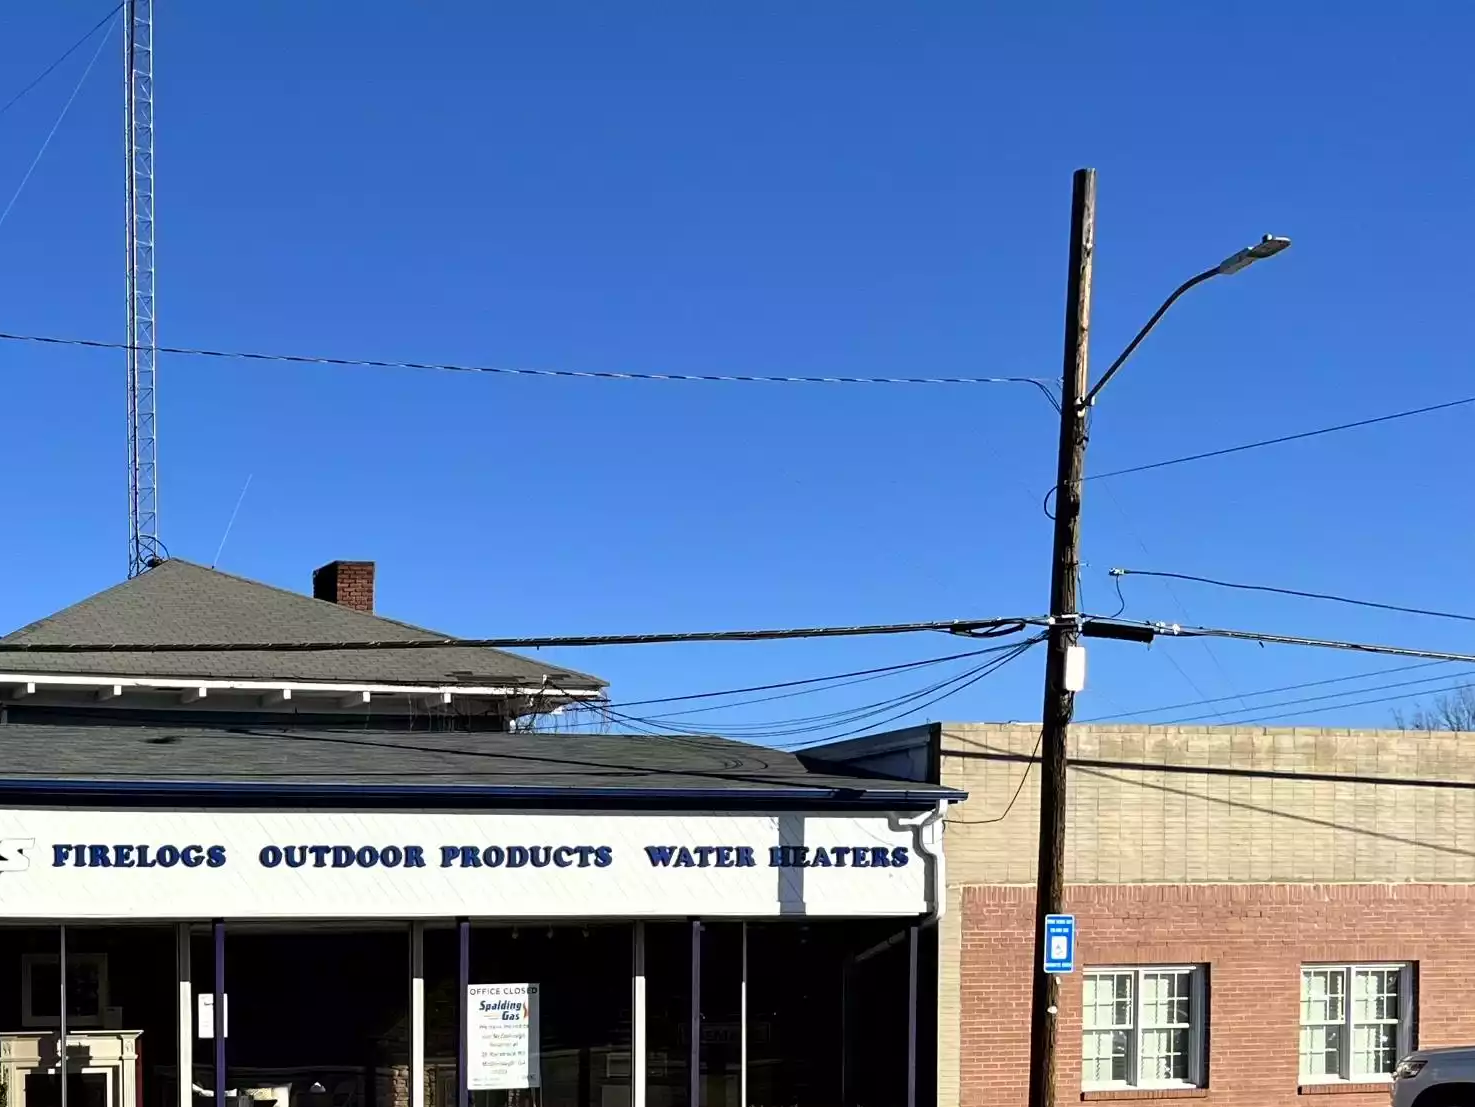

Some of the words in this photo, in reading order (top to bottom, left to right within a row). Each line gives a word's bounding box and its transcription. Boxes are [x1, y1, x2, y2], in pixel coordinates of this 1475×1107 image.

[52, 844, 226, 868] FIRELOGS
[259, 845, 426, 868] OUTDOOR
[440, 845, 613, 868] PRODUCTS
[643, 846, 756, 868] WATER
[768, 846, 910, 868] HEATERS
[503, 987, 538, 995] CLOSED
[479, 1000, 522, 1012] Spalding
[502, 1011, 520, 1021] Gas
